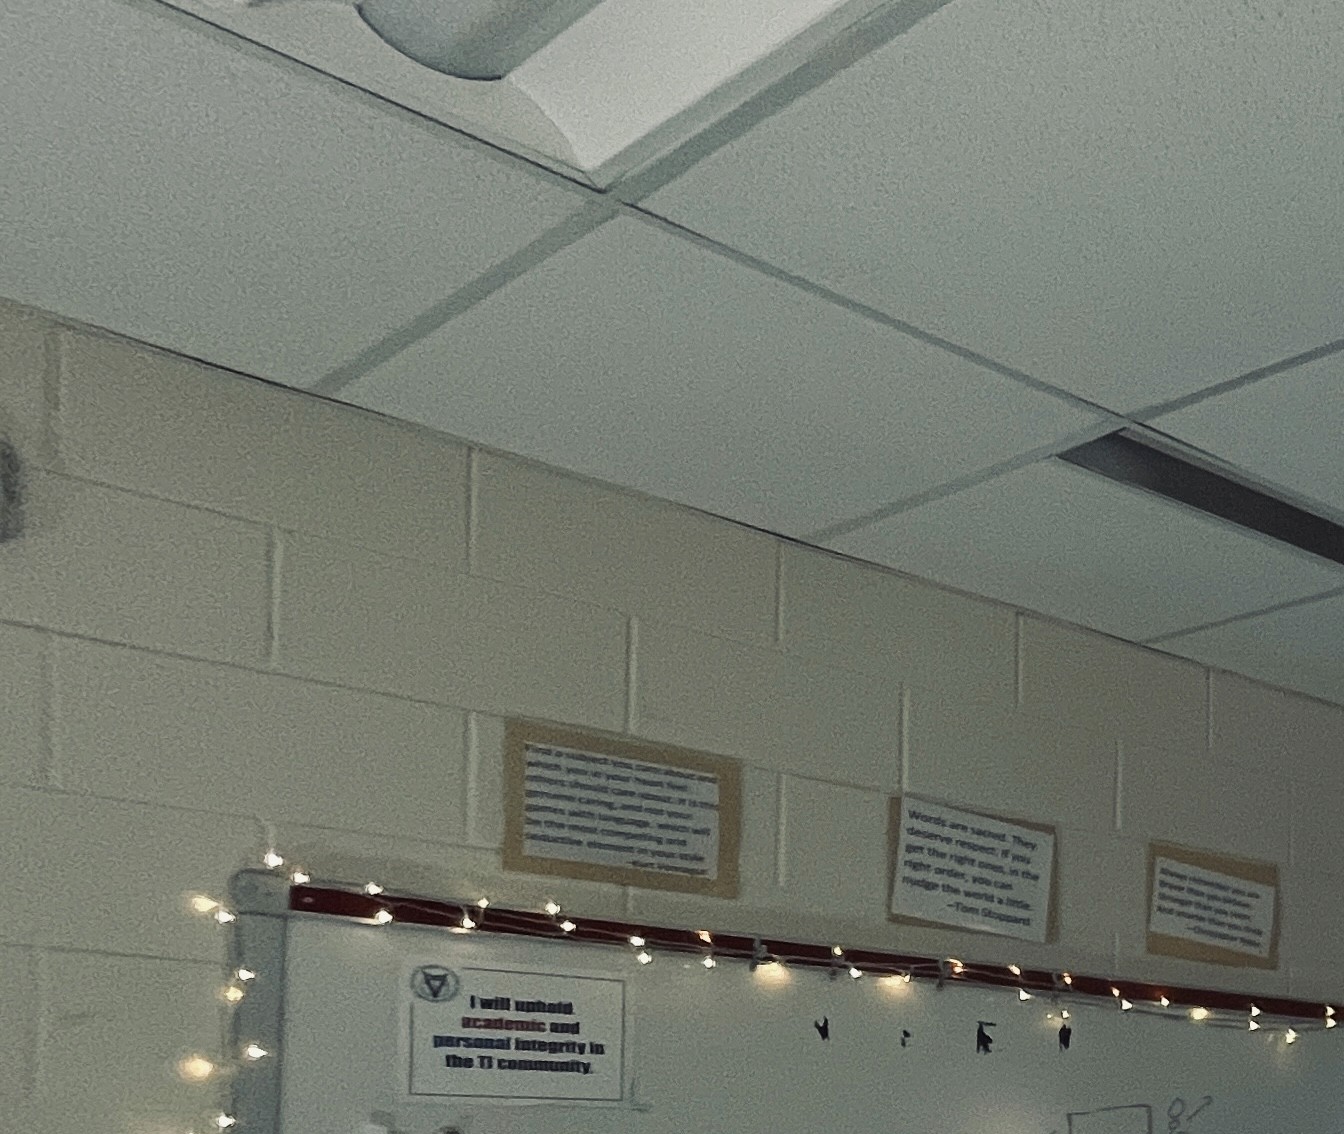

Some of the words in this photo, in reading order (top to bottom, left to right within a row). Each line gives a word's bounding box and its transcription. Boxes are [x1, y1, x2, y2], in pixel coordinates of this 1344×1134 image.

[908, 809, 946, 827] Words
[948, 821, 968, 833] are
[906, 826, 953, 845] deserve
[1011, 852, 1031, 866] you
[905, 843, 924, 855] get
[927, 847, 947, 860] the
[949, 853, 976, 867] right
[1021, 870, 1040, 882] the
[903, 859, 932, 872] right
[971, 875, 992, 887] you
[993, 880, 1013, 891] can
[941, 883, 961, 895] the
[963, 889, 995, 903] world
[470, 994, 476, 1010] I
[480, 996, 511, 1011] will
[461, 1015, 547, 1033] academic
[550, 1021, 580, 1035] and
[433, 1034, 511, 1051] personal
[514, 1037, 587, 1056] integrity
[589, 1041, 605, 1056] in
[445, 1054, 474, 1069] the
